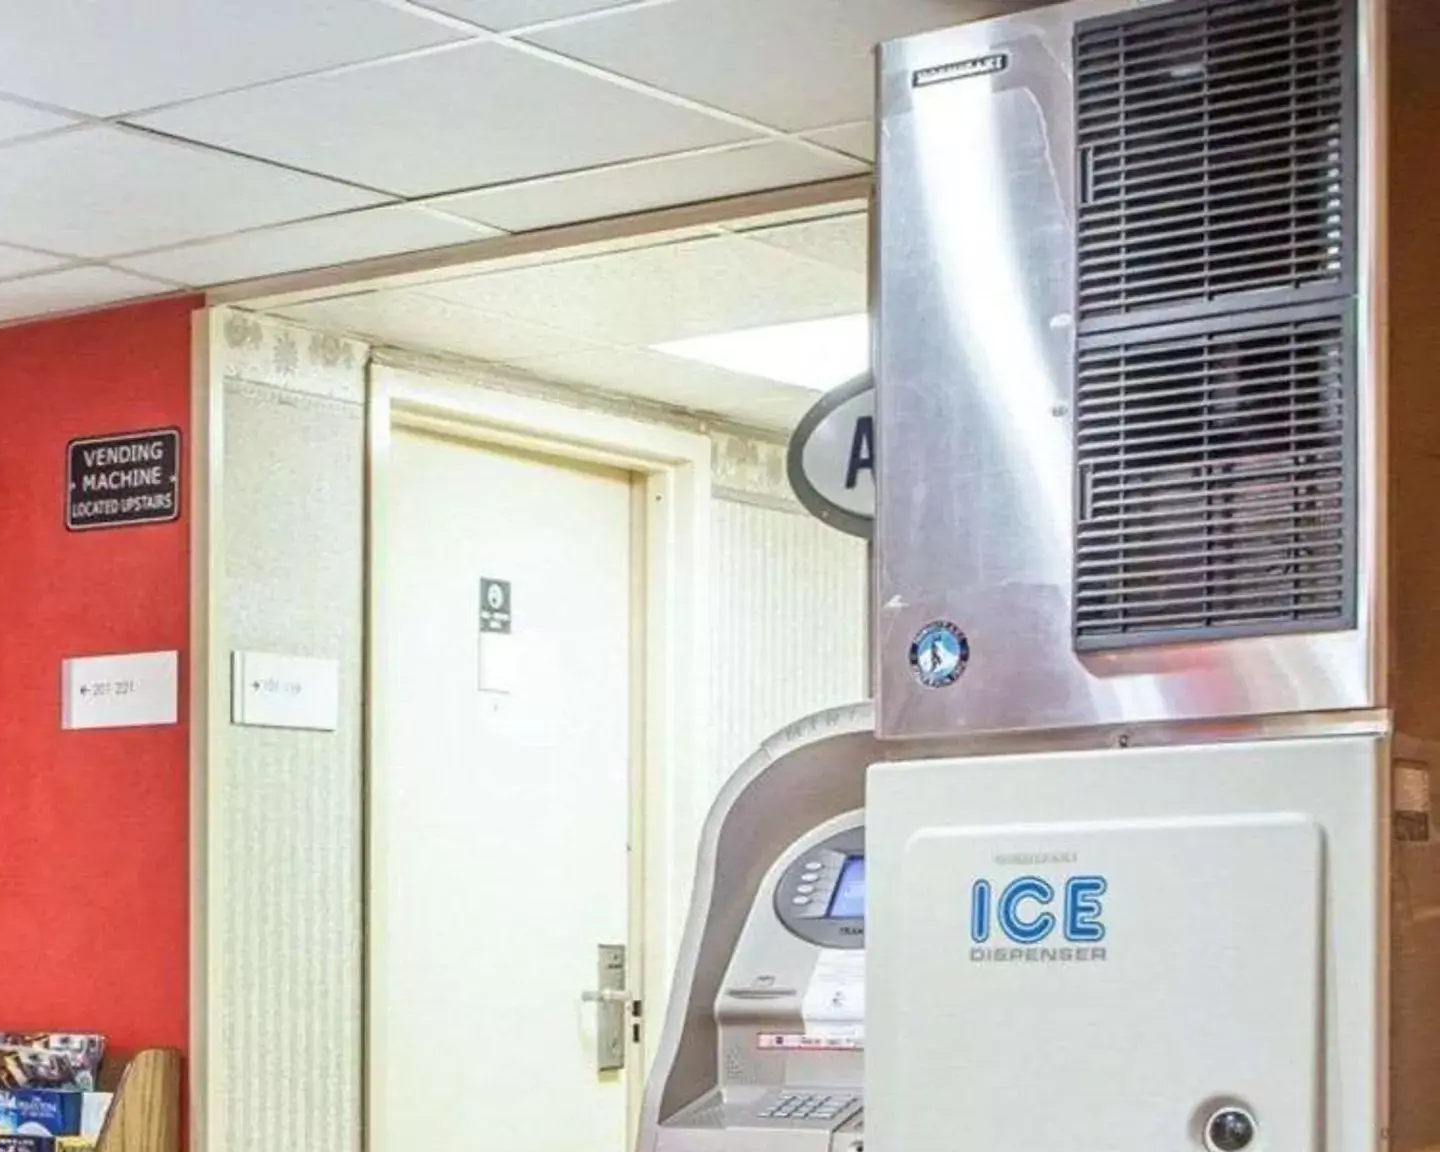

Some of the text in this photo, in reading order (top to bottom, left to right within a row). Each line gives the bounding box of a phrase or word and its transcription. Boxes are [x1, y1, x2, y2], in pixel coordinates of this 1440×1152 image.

[83, 441, 164, 468] VENDING
[82, 466, 162, 491] MACHINE
[72, 493, 172, 518] LOCATED UPSTAIRS
[971, 876, 1107, 944] ICE
[970, 947, 1107, 962] DISPENSER
